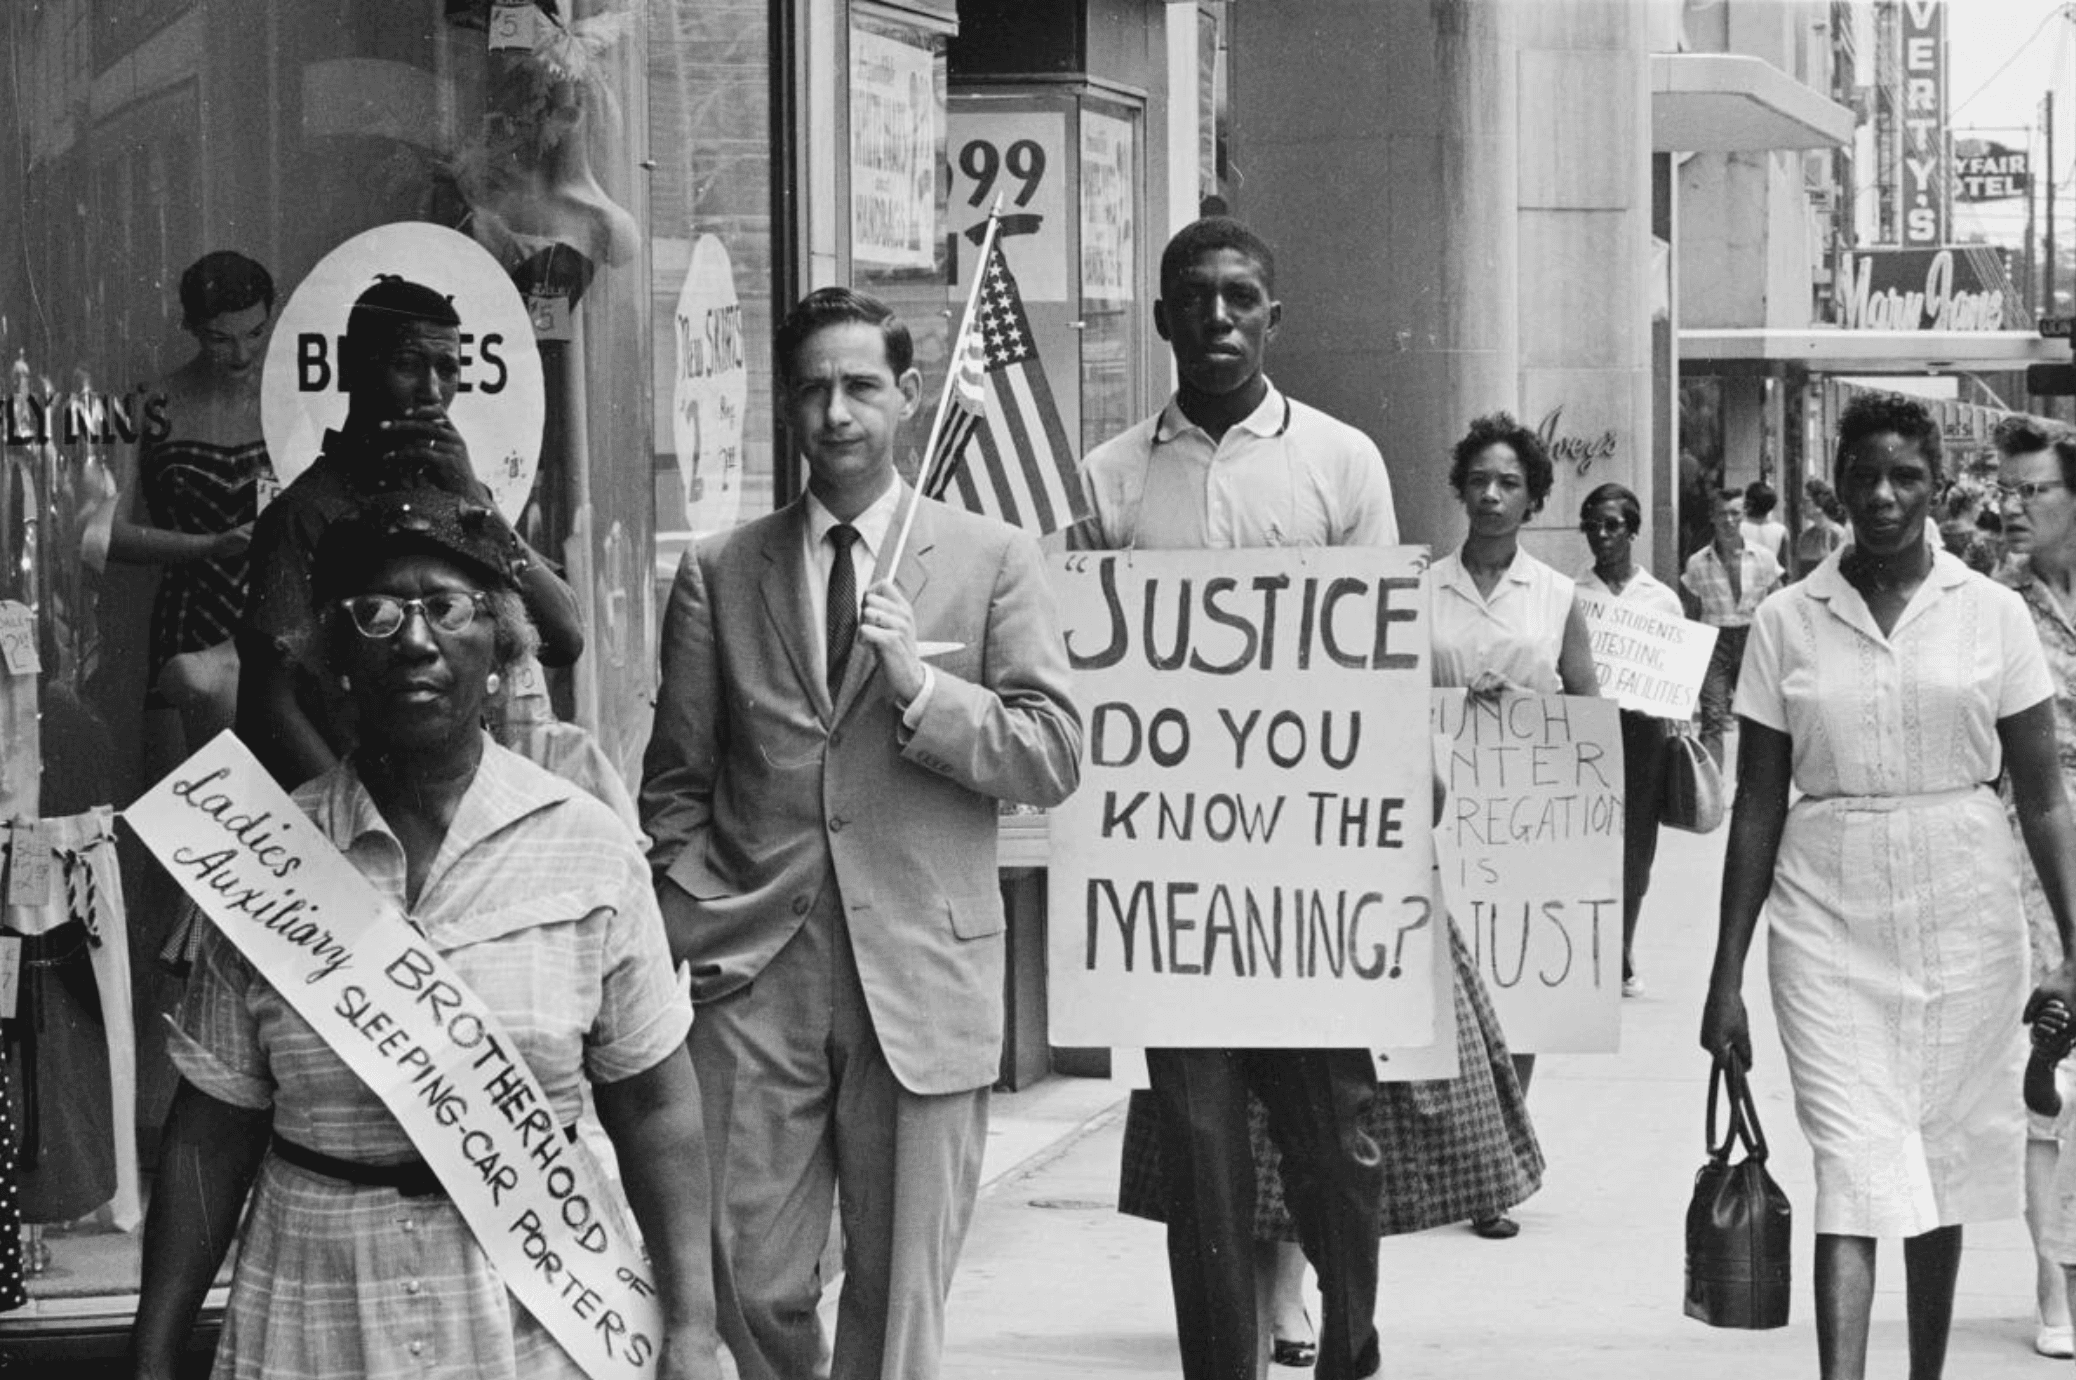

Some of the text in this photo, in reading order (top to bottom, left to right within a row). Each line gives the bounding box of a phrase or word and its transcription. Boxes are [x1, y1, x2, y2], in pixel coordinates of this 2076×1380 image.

[1611, 607, 1684, 644] STUDENTS
[1615, 667, 1695, 706] FACILITIES
[1091, 702, 1361, 769] DO YOU
[172, 767, 301, 878] Ladies
[1101, 791, 1405, 849] KNOW THE
[173, 847, 353, 984] Auxiliary
[1461, 857, 1499, 889] IS
[1086, 878, 1432, 981] MEANING?
[384, 947, 656, 1298] BROTHERHOOD OF
[334, 985, 653, 1368] SLEEPING-CAR PORTERS
